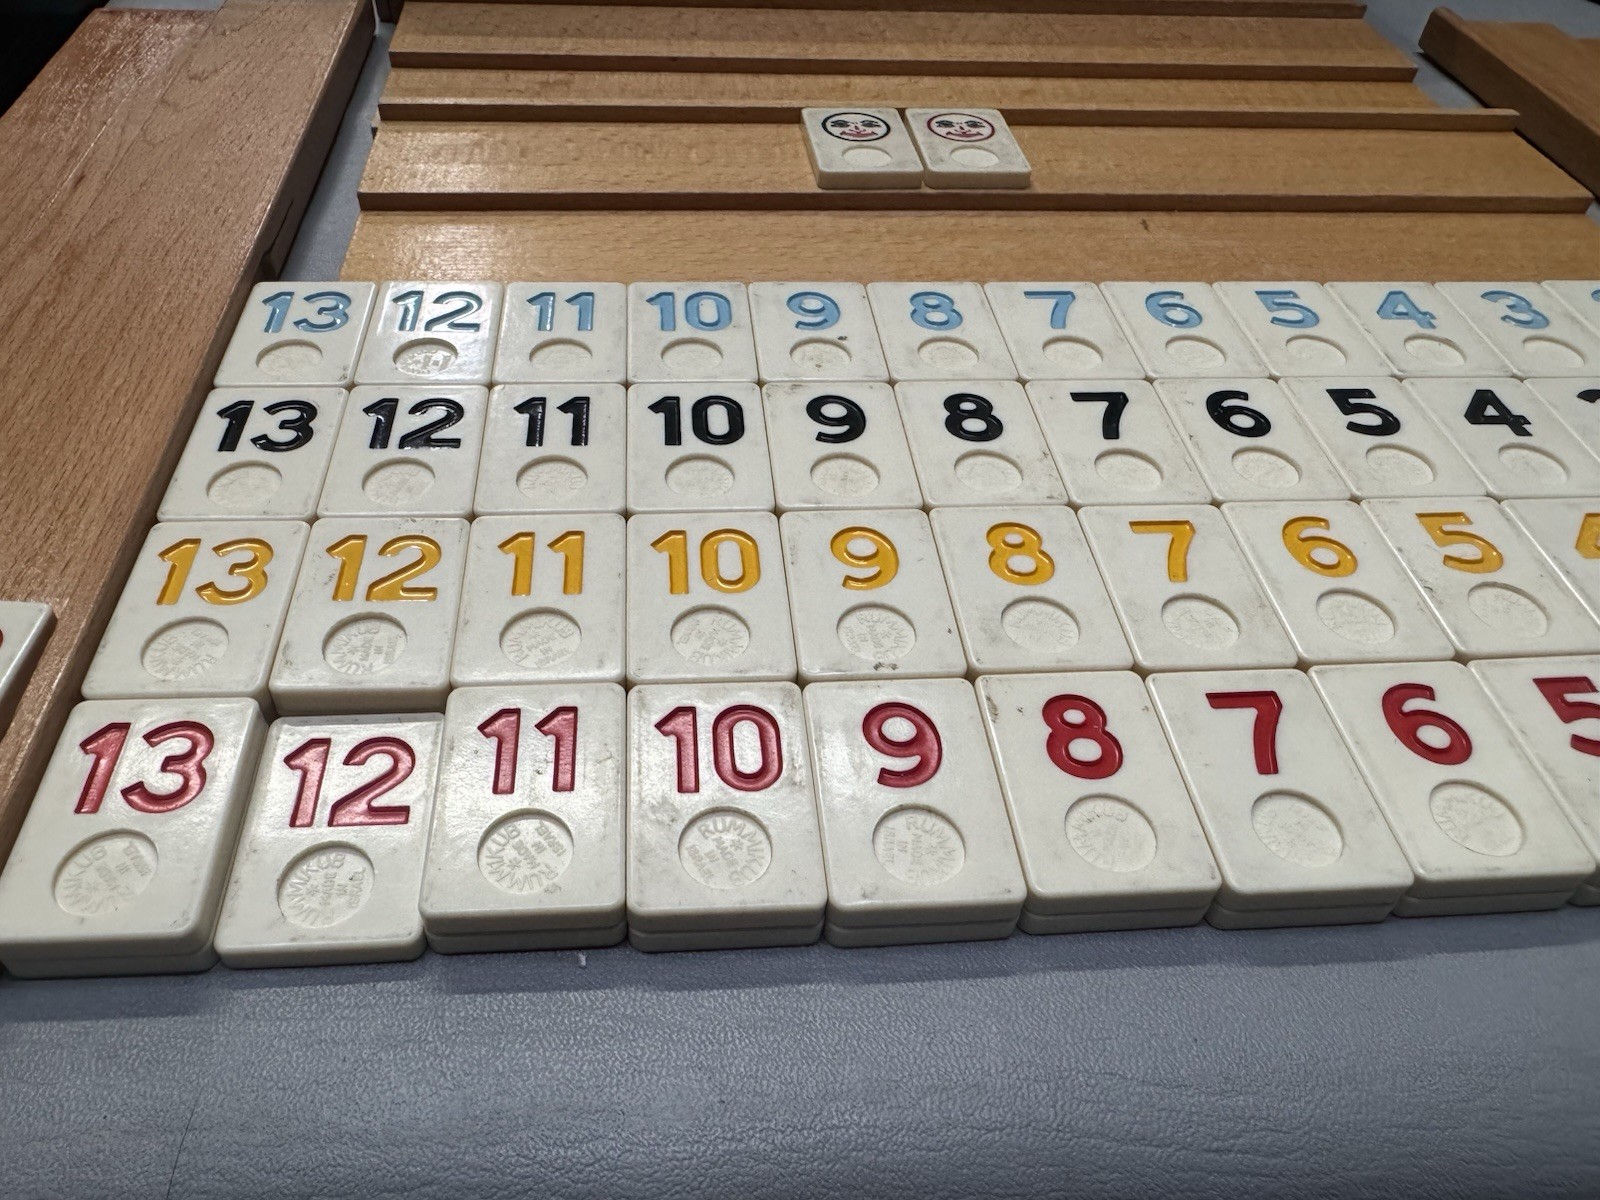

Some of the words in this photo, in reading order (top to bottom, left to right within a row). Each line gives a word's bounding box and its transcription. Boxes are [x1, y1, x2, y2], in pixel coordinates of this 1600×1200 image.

[261, 291, 352, 332] 13
[392, 290, 481, 332] 12
[526, 291, 594, 331] 11
[647, 290, 731, 330] 10
[787, 290, 840, 328] 9
[909, 290, 963, 329] 8
[1023, 290, 1076, 329] 7
[1145, 290, 1202, 327] 6
[1255, 290, 1319, 327] 5
[1376, 290, 1436, 328] 4
[1480, 290, 1550, 329] 3
[216, 400, 318, 453] 13
[362, 397, 465, 449] 12
[513, 396, 591, 447] 11
[648, 395, 745, 446] 10
[805, 394, 867, 444] 9
[943, 392, 1004, 443] 8
[1069, 391, 1130, 440] 7
[1205, 390, 1272, 438] 6
[1325, 388, 1401, 437] 5
[1463, 389, 1533, 437] 4
[326, 534, 440, 602] 12
[498, 530, 586, 597] 11
[650, 528, 761, 595] 10
[830, 526, 900, 591] 9
[986, 522, 1056, 586] 8
[1129, 520, 1197, 583] 7
[1281, 516, 1358, 578] 6
[1415, 511, 1504, 573] 5
[157, 537, 275, 606] 13
[1041, 693, 1124, 780] 8
[1205, 690, 1284, 775] 7
[1381, 682, 1474, 766] 6
[1532, 676, 1600, 757] 5
[75, 719, 216, 815] 13
[477, 706, 580, 795] 11
[654, 704, 784, 793] 10
[861, 701, 943, 789] 9
[283, 736, 417, 829] 12
